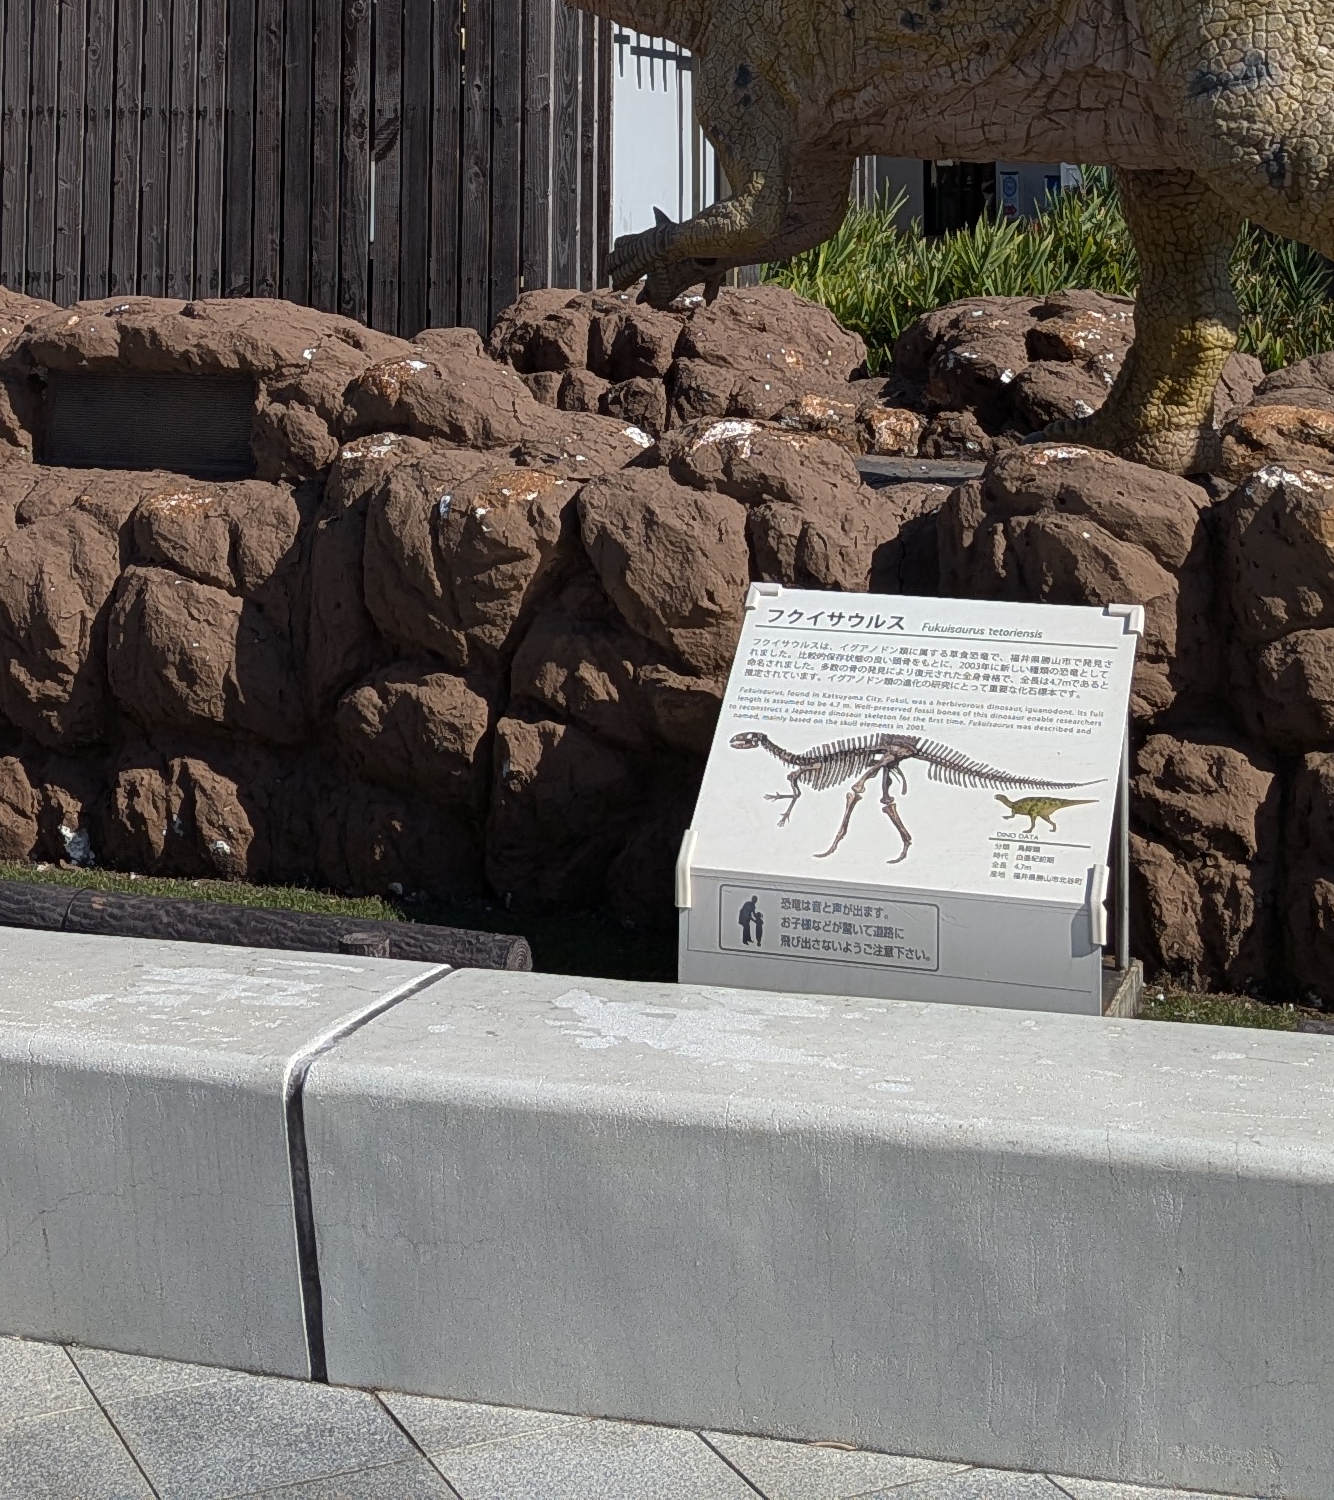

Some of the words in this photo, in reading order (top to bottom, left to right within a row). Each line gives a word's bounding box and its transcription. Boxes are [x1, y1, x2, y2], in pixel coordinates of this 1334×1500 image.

[767, 608, 906, 631] フクイサウルス
[921, 622, 985, 635] Fukuisaurus
[989, 627, 1043, 639] tetoriensis
[1018, 833, 1039, 841] DATA
[780, 897, 889, 919] 恐竜は音と声が出ます。
[780, 916, 905, 940] お子様などが驚いて道路に
[780, 934, 931, 962] 飛び出さないようご注意下さい。
